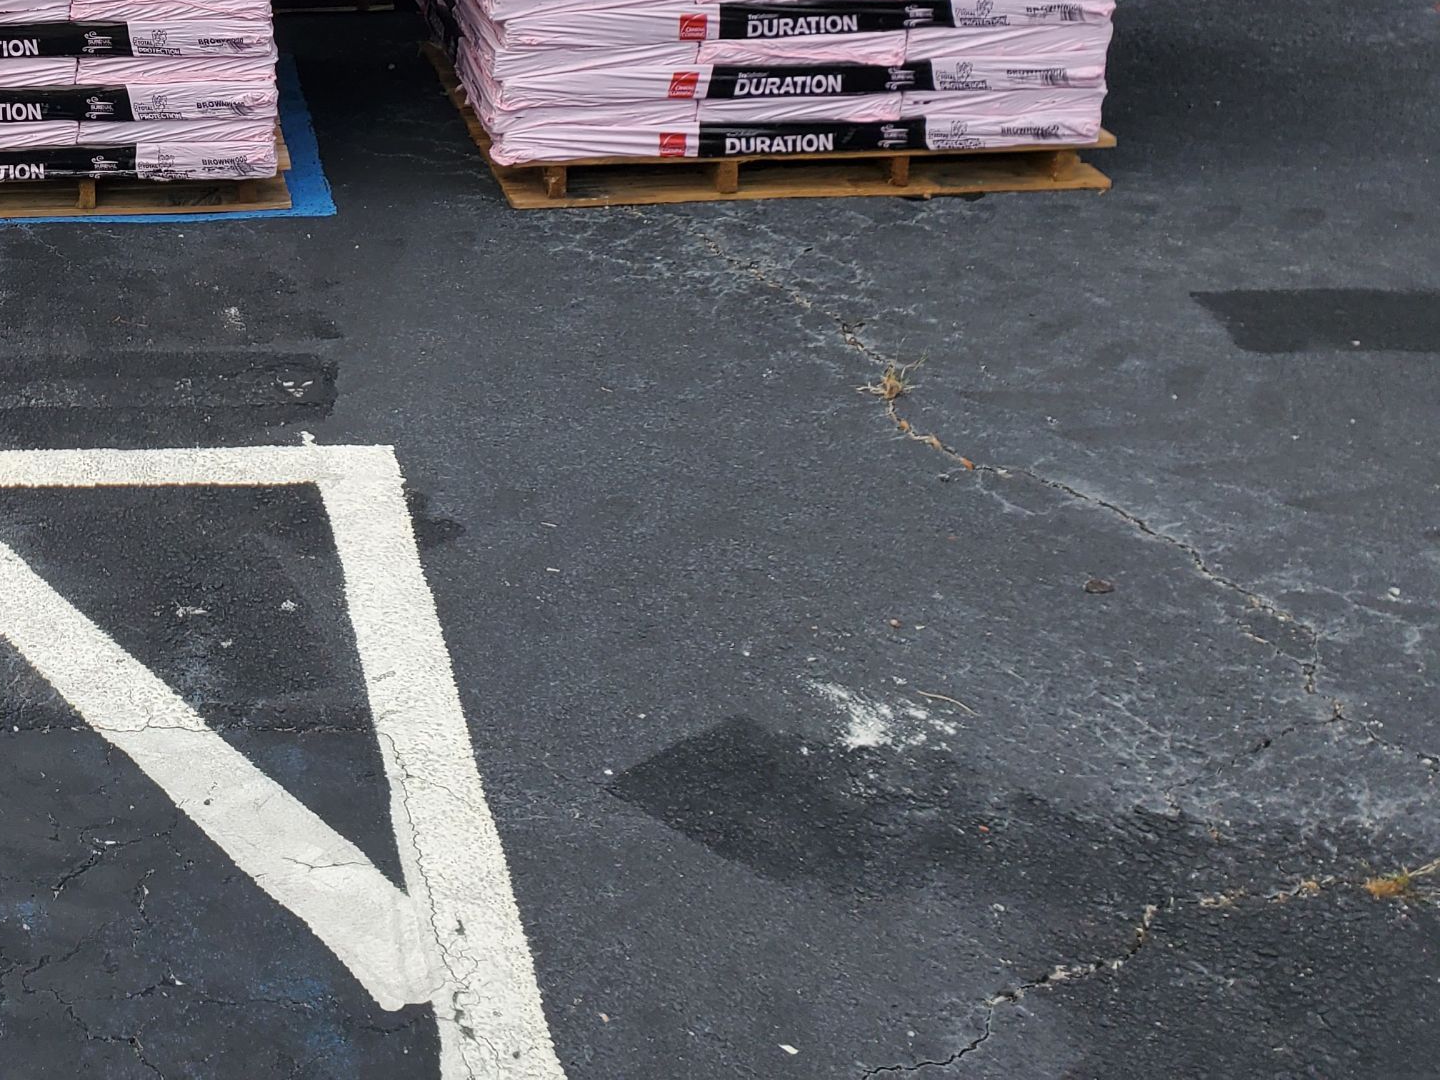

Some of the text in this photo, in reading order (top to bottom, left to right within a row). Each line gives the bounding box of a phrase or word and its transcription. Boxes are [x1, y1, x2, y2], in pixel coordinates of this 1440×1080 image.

[747, 14, 858, 37] DURATION
[734, 74, 843, 96] DURATION
[139, 112, 182, 121] PROTECTION
[725, 133, 835, 155] DURATION
